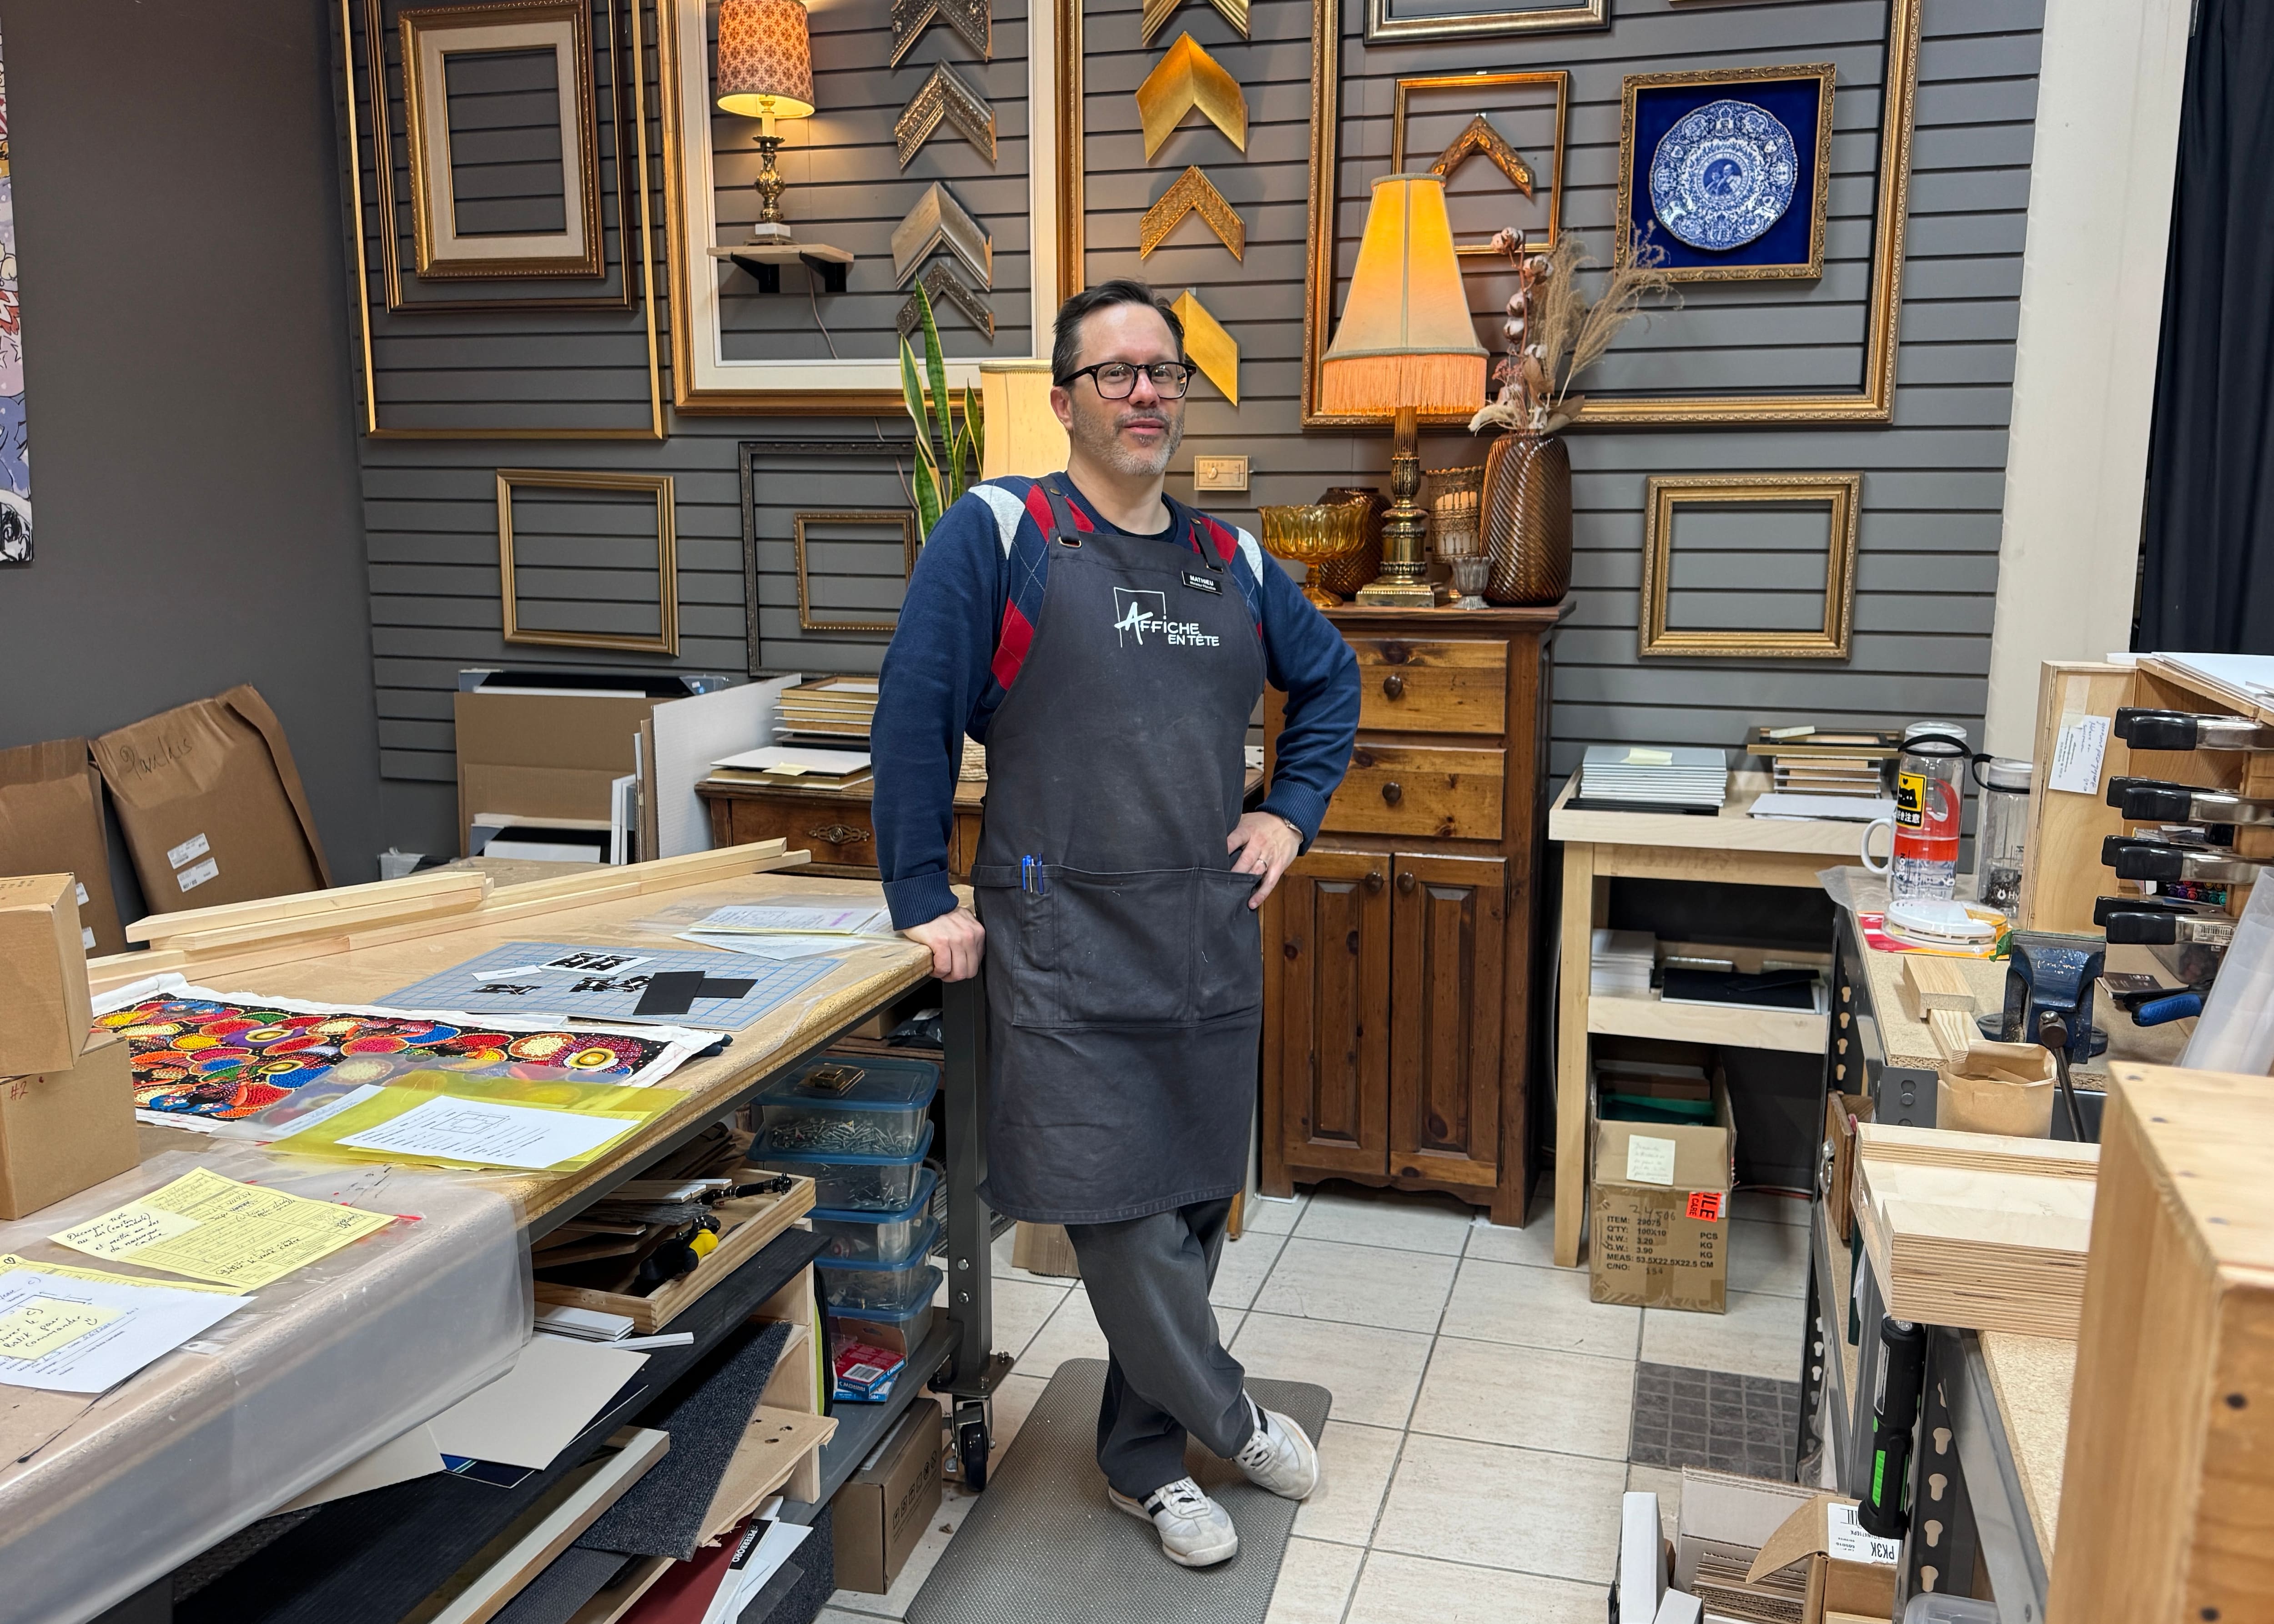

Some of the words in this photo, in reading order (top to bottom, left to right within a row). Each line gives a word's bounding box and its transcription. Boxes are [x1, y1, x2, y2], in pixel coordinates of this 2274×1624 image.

[1190, 575, 1213, 586] MATHIEU
[1168, 634, 1185, 645] EN
[1187, 634, 1220, 646] TÊTE
[1690, 1198, 1699, 1216] CARE
[1700, 1192, 1719, 1219] ILE
[1607, 1216, 1630, 1224] ITEM:
[843, 1383, 865, 1392] ARROW
[732, 1528, 759, 1562] PETERBORO
[1871, 1541, 1895, 1560] PK3K
